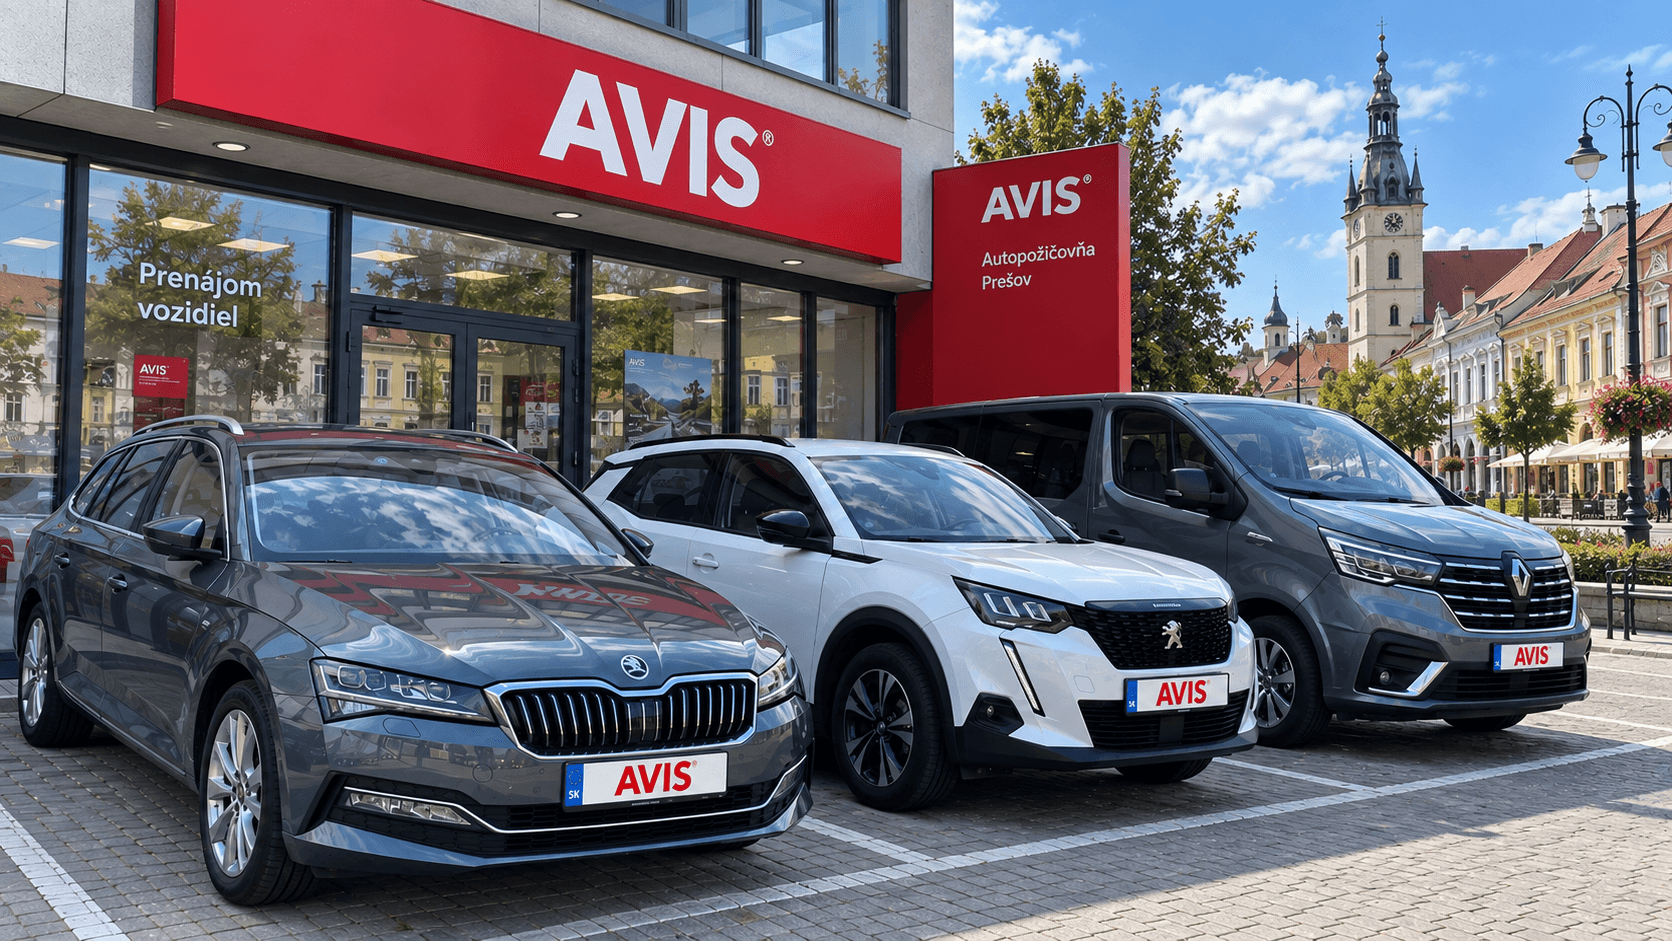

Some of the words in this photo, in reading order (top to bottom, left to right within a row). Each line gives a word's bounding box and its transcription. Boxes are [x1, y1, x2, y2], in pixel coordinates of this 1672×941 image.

[981, 241, 1096, 267] Autopožičovňa
[139, 262, 262, 299] Prenájom
[981, 272, 1032, 290] Prešov
[137, 300, 238, 328] vozidiel
[1513, 645, 1549, 666] AVIS
[1155, 679, 1207, 707] AVIS
[568, 789, 580, 800] SK
